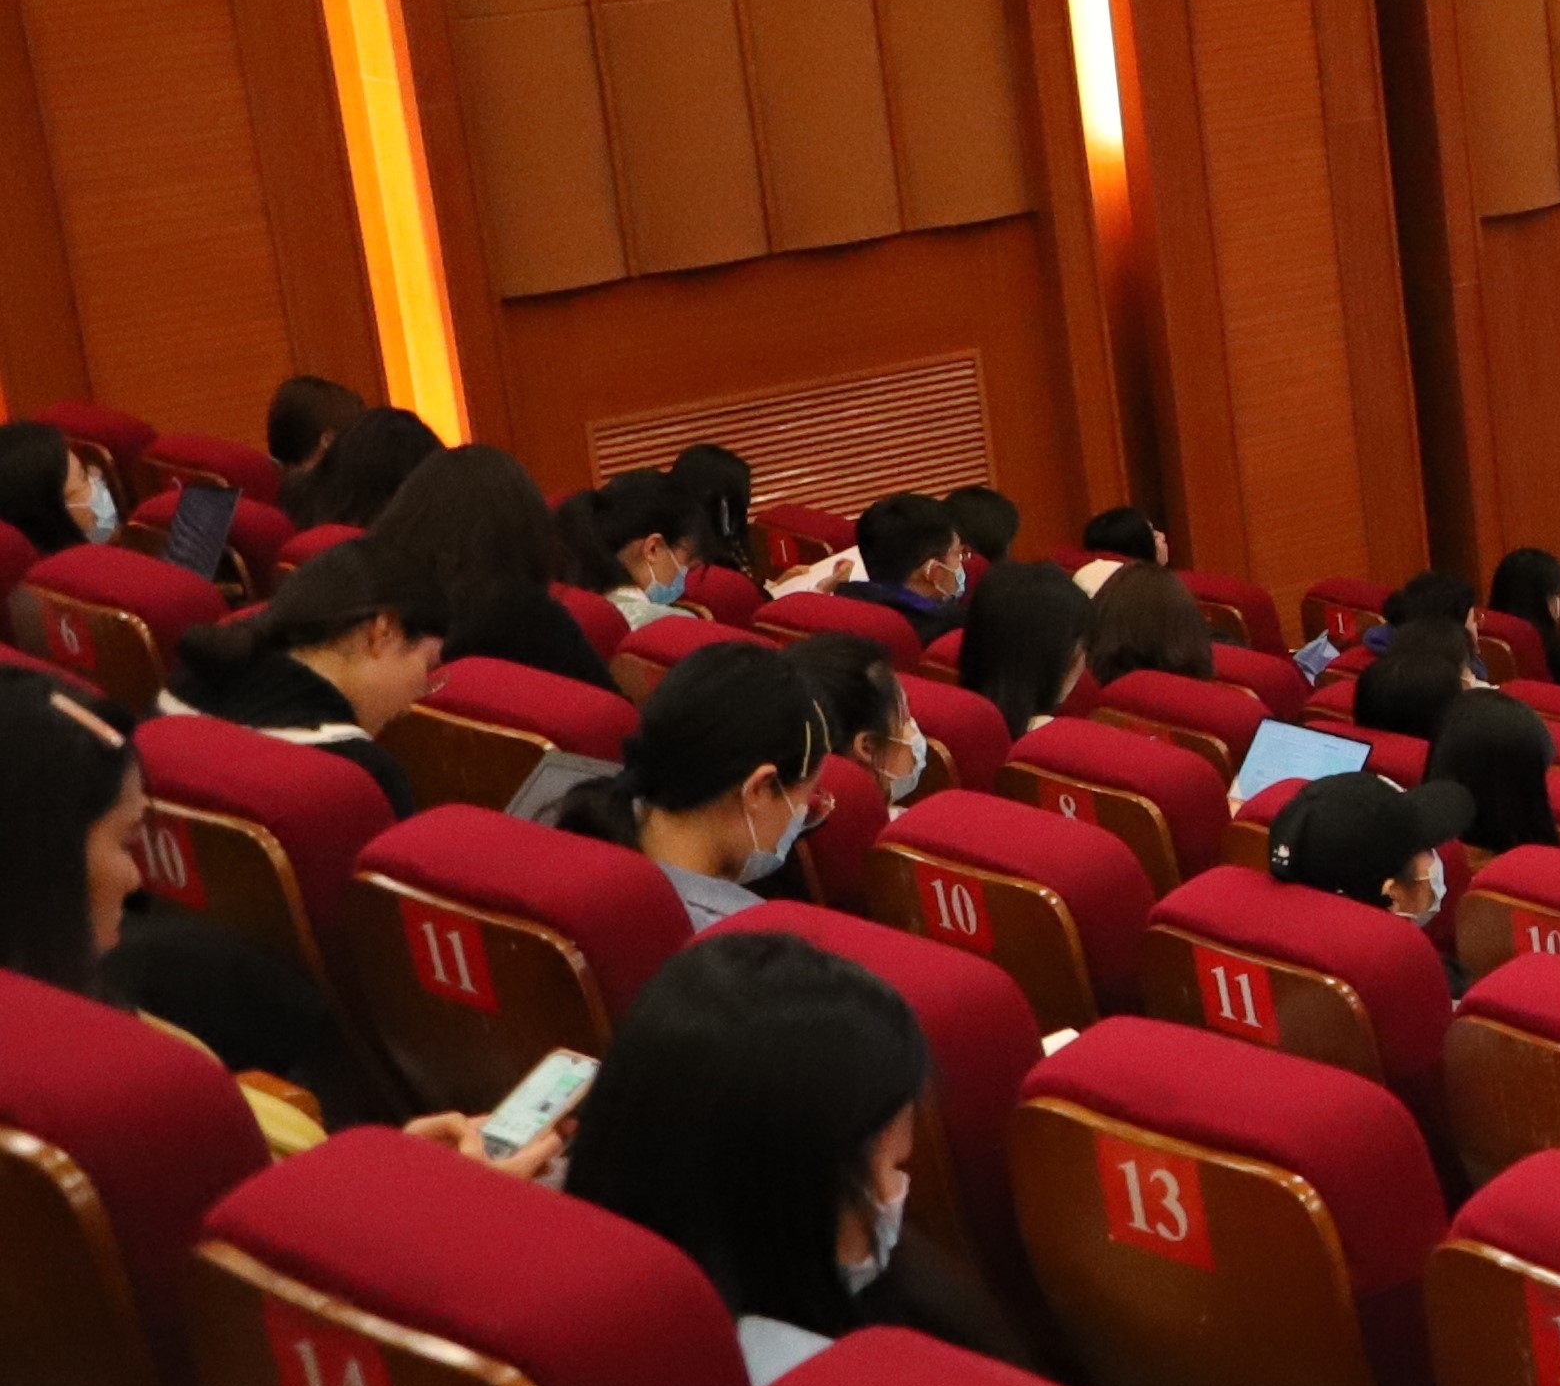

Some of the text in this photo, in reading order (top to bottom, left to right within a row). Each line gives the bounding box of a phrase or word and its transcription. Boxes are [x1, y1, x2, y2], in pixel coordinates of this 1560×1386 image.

[929, 877, 978, 935] 10
[420, 921, 480, 997] 11
[1210, 965, 1262, 1028] 11
[1119, 1160, 1188, 1243] 13
